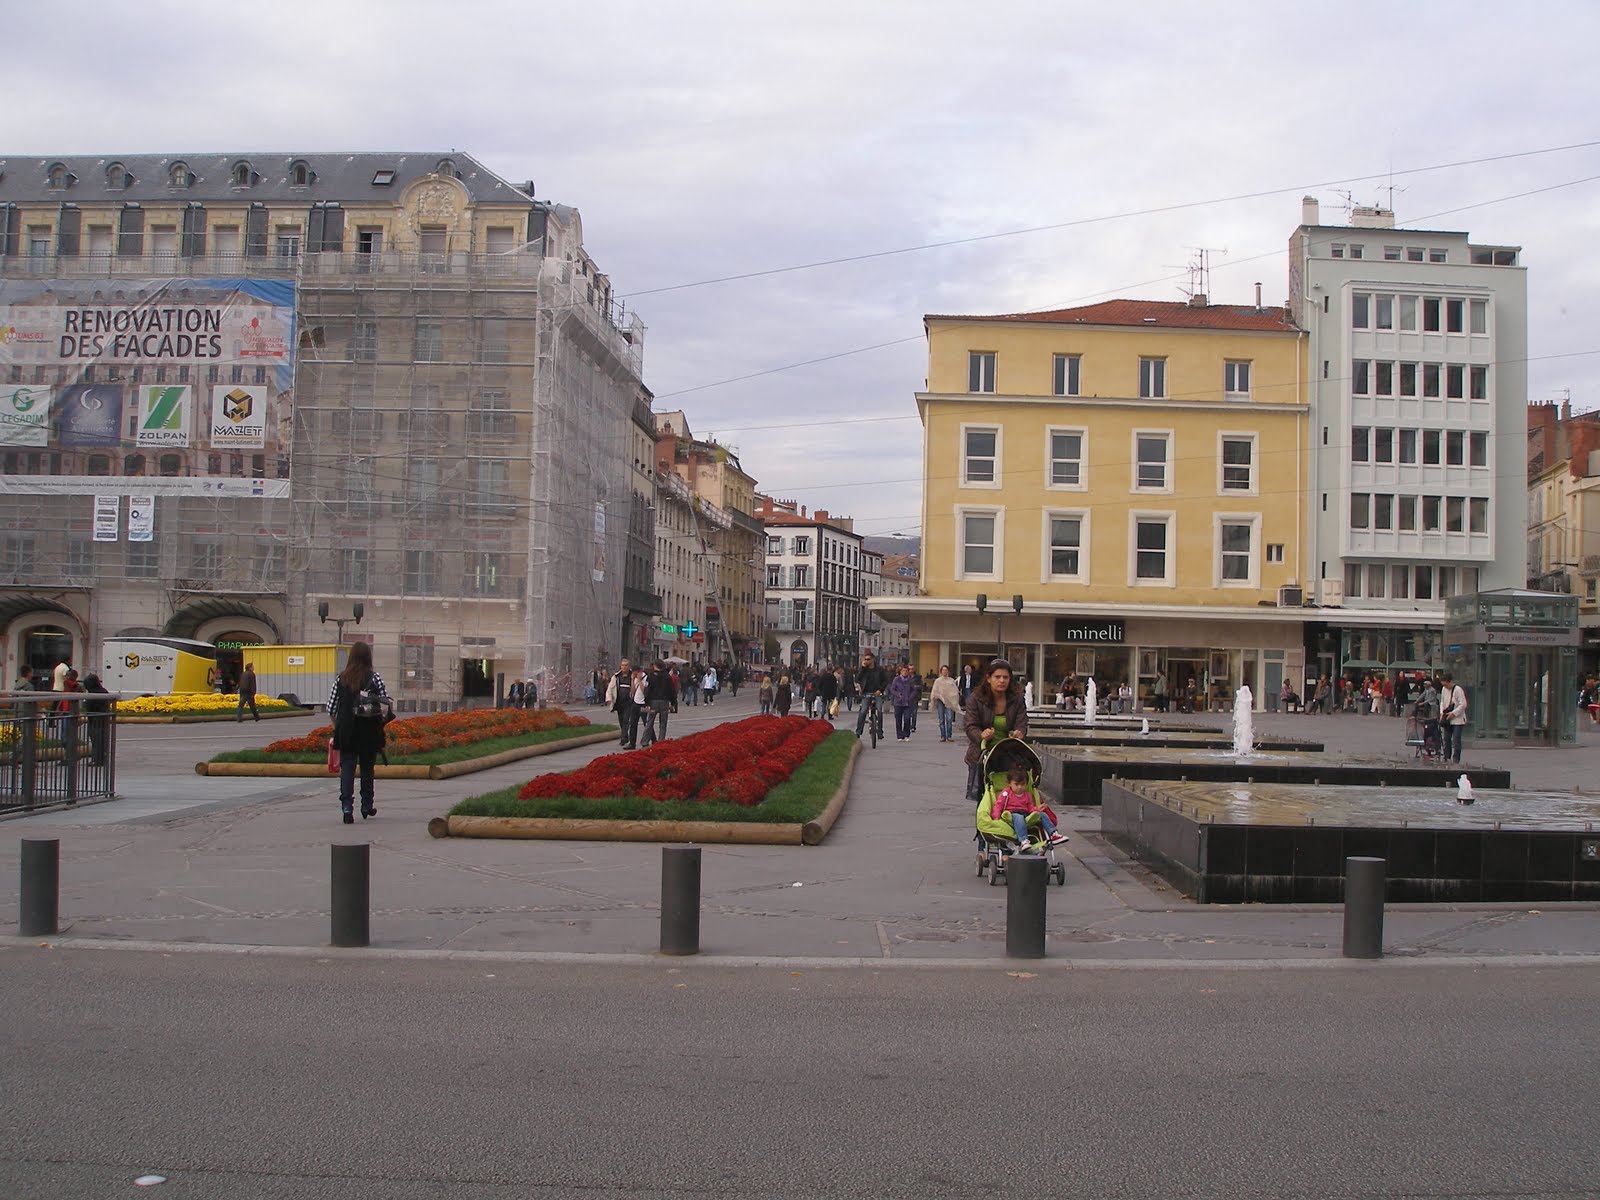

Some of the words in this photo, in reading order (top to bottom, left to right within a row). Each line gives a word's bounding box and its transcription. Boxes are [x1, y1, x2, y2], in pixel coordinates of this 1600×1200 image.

[65, 309, 222, 333] RENOVATION
[60, 335, 104, 358] DES
[113, 334, 222, 358] FACADES
[214, 425, 262, 436] MAZET
[1067, 625, 1122, 640] minelli
[218, 641, 264, 649] PHARMAC
